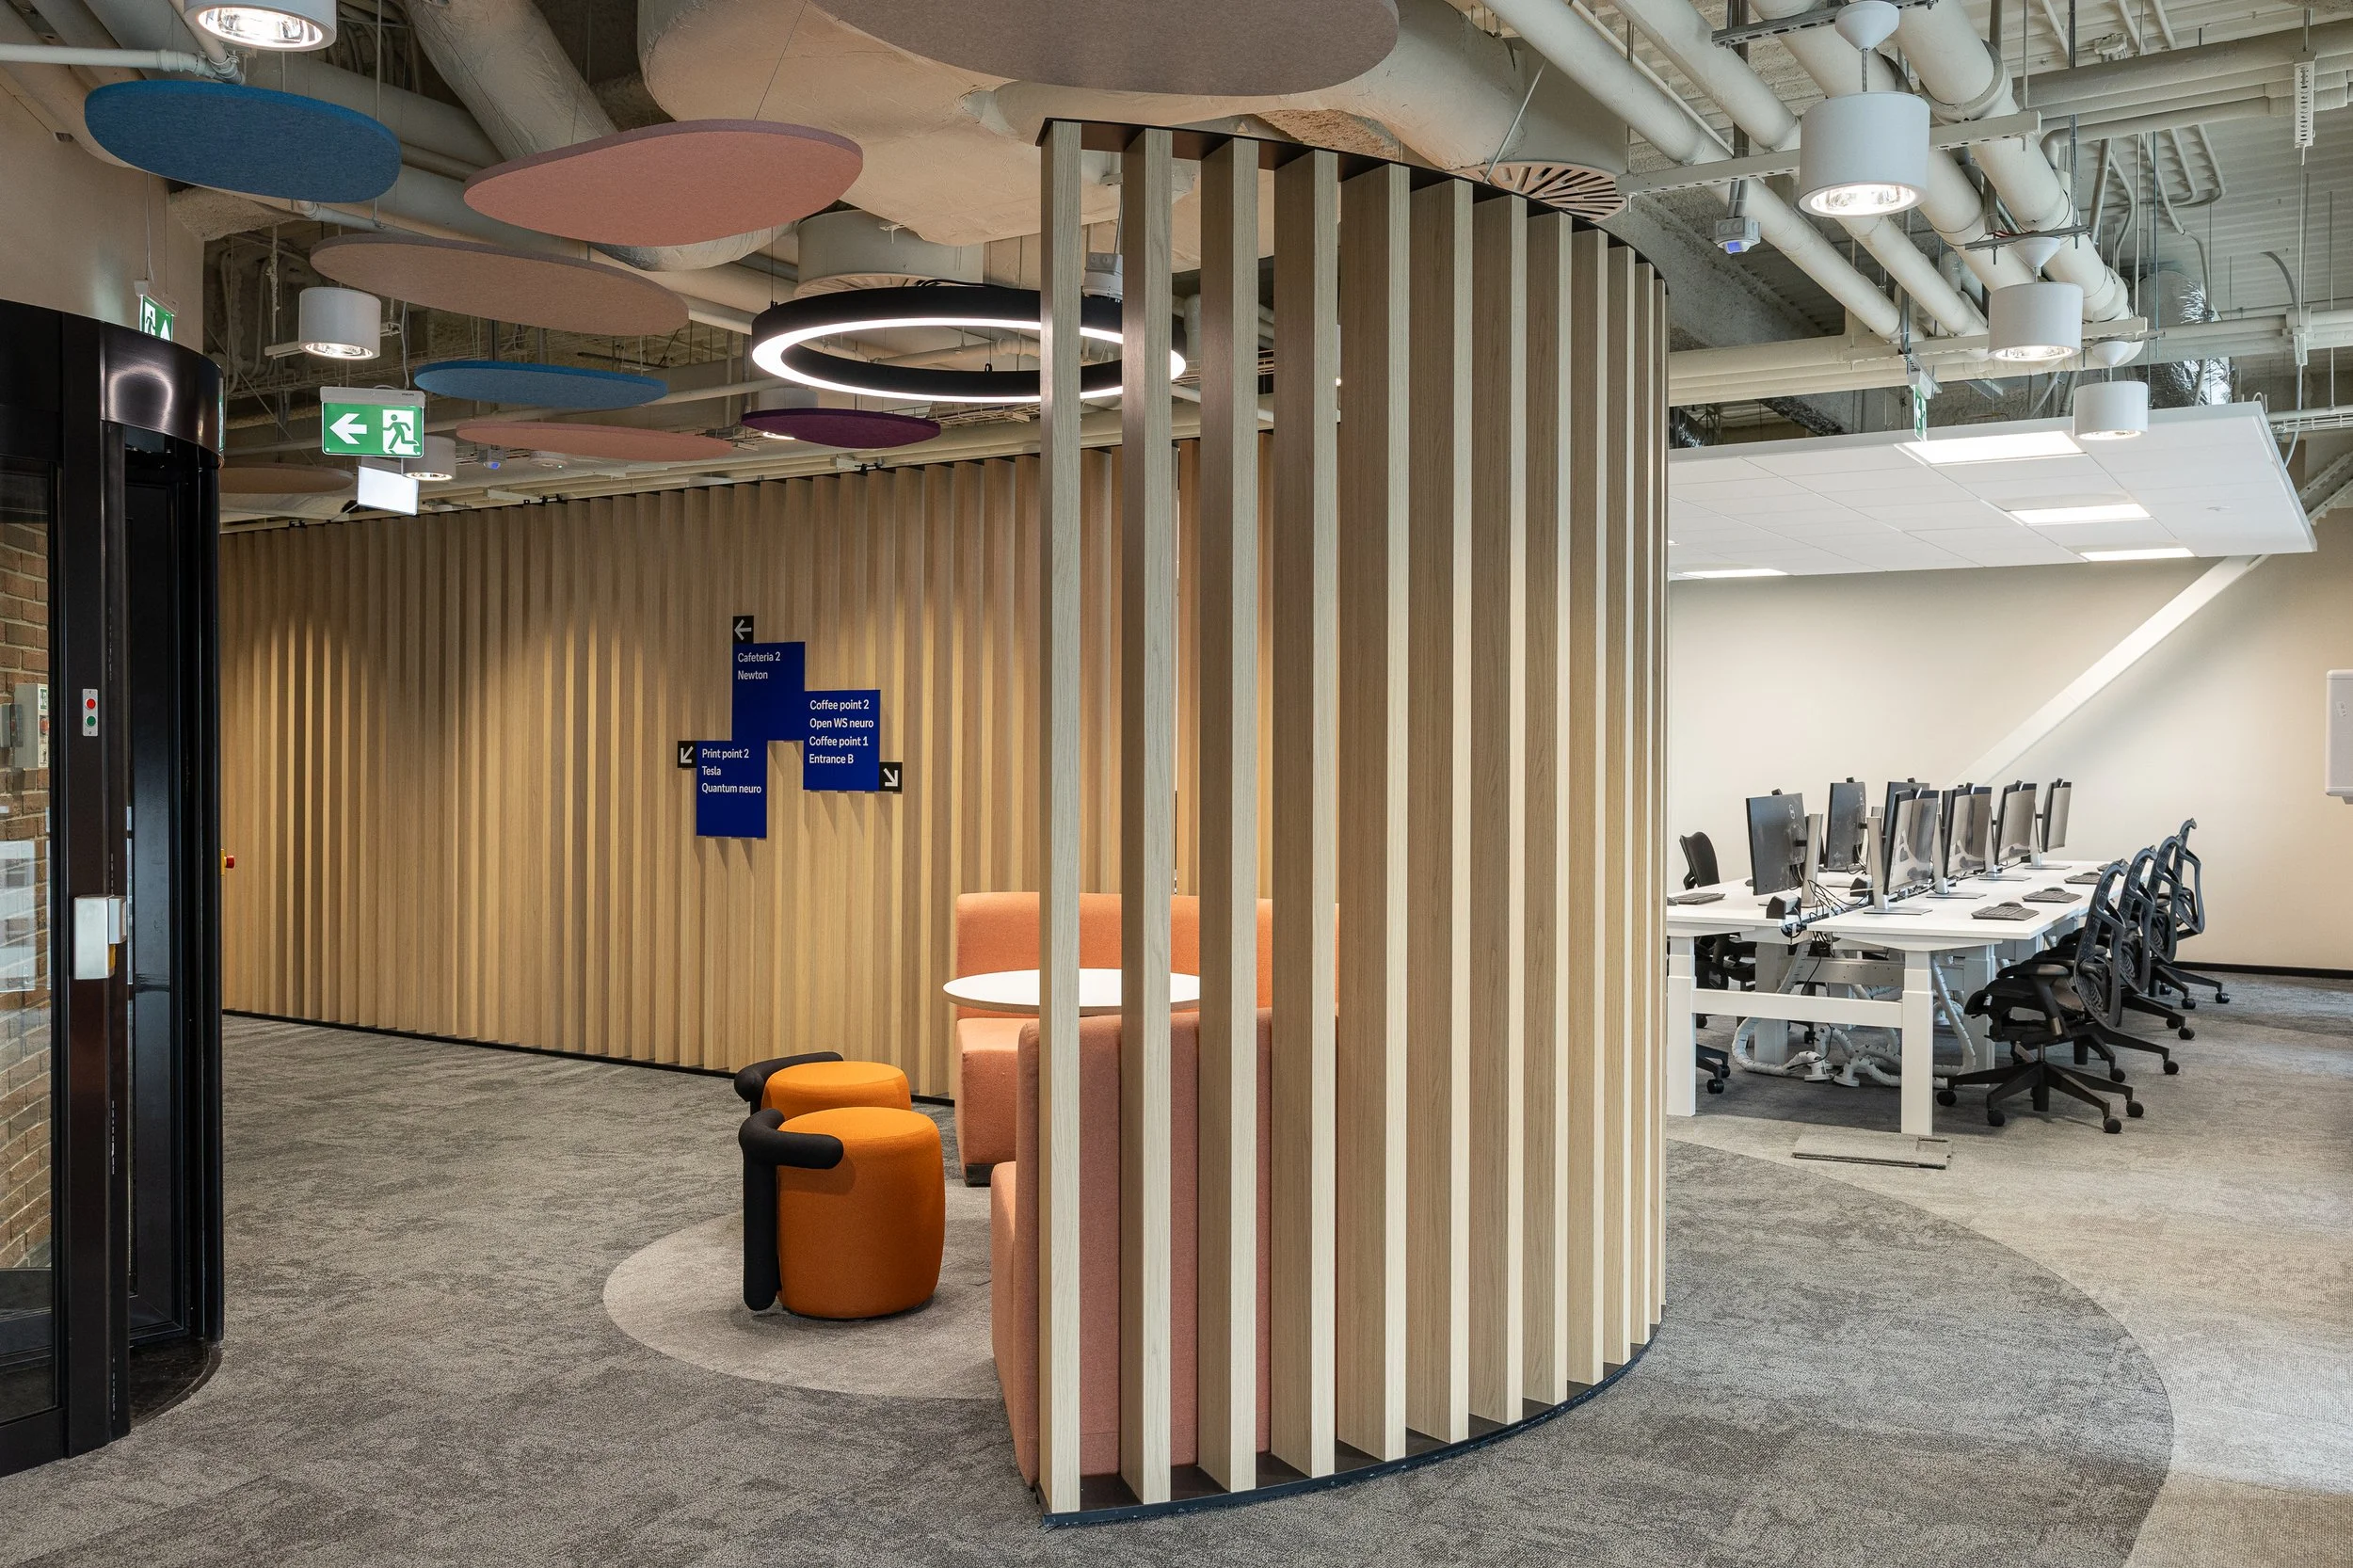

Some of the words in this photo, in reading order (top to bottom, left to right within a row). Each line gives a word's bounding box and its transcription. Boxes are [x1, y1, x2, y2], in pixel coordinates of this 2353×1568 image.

[737, 651, 774, 663] Cafeteria
[775, 651, 781, 662] 2
[737, 670, 769, 680] Newton
[809, 699, 839, 711] Coffee
[840, 699, 862, 712] point
[863, 698, 870, 710] 2
[809, 717, 832, 730] Open
[833, 717, 848, 728] WS
[849, 719, 874, 728] neuro
[808, 735, 838, 746] Coffee
[839, 735, 861, 748] point
[862, 736, 869, 746] 1
[701, 748, 721, 759] Print
[722, 748, 743, 760] point
[744, 748, 750, 759] 2
[808, 753, 846, 764] Entrance
[847, 753, 855, 764] B
[701, 765, 722, 776] Tesla
[701, 782, 738, 794] Quantum
[739, 785, 762, 793] neuro
